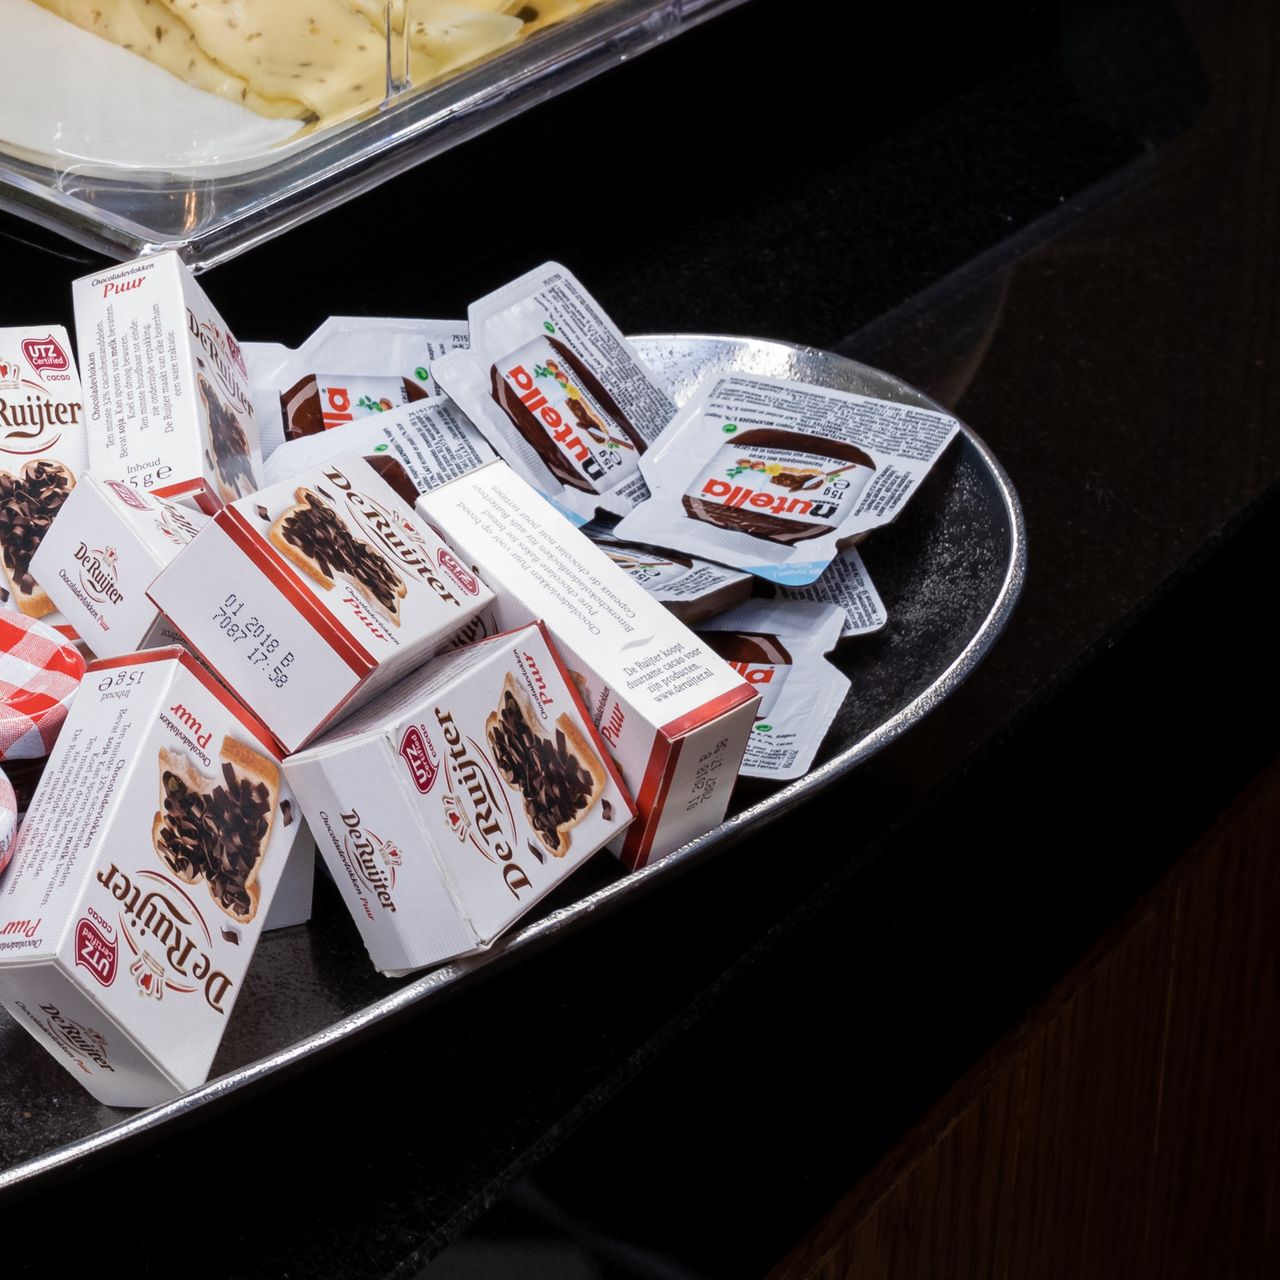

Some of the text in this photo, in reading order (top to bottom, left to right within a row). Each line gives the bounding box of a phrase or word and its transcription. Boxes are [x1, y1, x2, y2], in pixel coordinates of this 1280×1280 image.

[91, 262, 155, 287] Chocoladevlokken
[103, 275, 147, 299] Puur
[28, 345, 57, 358] UTZ
[32, 353, 64, 365] Certified
[186, 306, 254, 418] De Ruijter
[46, 373, 71, 381] cacao
[88, 352, 99, 420] Chocoladevlokken
[507, 365, 607, 481] nutella
[126, 457, 161, 474] Inhoud
[701, 478, 838, 520] nutella
[322, 465, 365, 507] De
[362, 505, 461, 607] Ruijter
[73, 541, 124, 606] De Ruijter
[58, 568, 110, 632] Chocoladevlokken Puur
[342, 597, 389, 643] Puur
[344, 586, 400, 645] Chocoladevlokken
[211, 609, 289, 688] 7087 17:58
[224, 593, 296, 668] 01 2018 B
[512, 648, 548, 720] Chocoladevlokken
[522, 651, 554, 707] Puur
[623, 643, 686, 678] De Ruijter koopt
[625, 648, 703, 691] duurzame cacao voor
[647, 664, 703, 694] zijn producten.
[99, 688, 130, 703] Inhoud
[653, 668, 715, 704] www.deruijter.nl
[159, 712, 211, 767] Chocoladevlokken
[170, 703, 212, 750] Puur
[420, 723, 437, 758] cacao
[601, 702, 625, 750] Puur
[405, 747, 427, 785] UTZ
[412, 734, 433, 780] Certified
[434, 706, 504, 845] Ruijter
[85, 759, 125, 849] Chocoladevlokken
[319, 810, 375, 922] Chocoladevlokken Puur
[340, 808, 397, 914] De Ruijter
[494, 840, 533, 901] De
[0, 918, 43, 938] Puur
[88, 906, 112, 934] cacao
[97, 863, 234, 1015] De Ruijter
[81, 938, 110, 977] UTZ
[82, 927, 113, 963] Certified
[39, 1002, 115, 1073] De Ruijter
